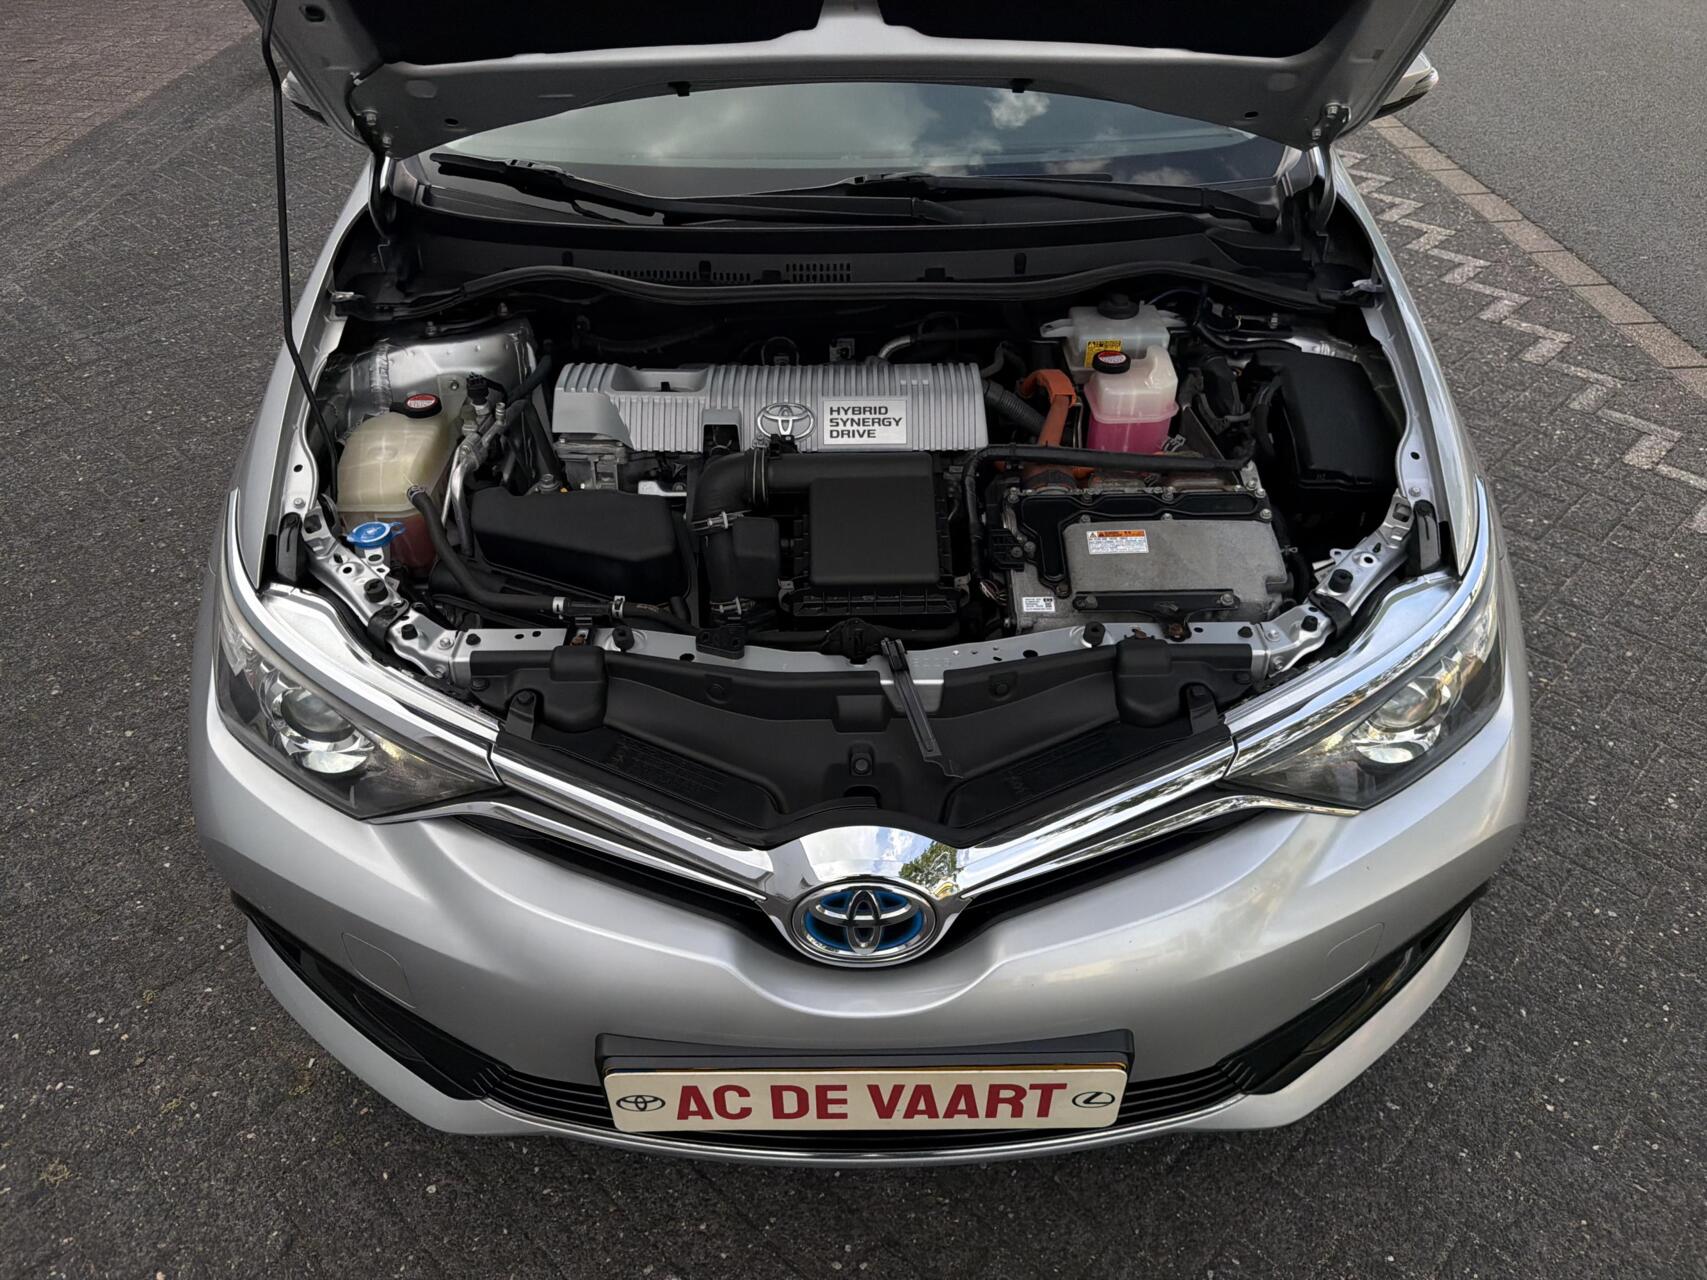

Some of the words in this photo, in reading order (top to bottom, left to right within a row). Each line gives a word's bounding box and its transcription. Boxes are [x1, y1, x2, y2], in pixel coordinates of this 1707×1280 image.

[829, 406, 889, 416] HYBRID
[829, 417, 903, 427] SYNERGY
[829, 429, 877, 439] DRIVE
[676, 1084, 752, 1121] AC
[770, 1084, 849, 1121] DE
[867, 1083, 1067, 1120] VAART
